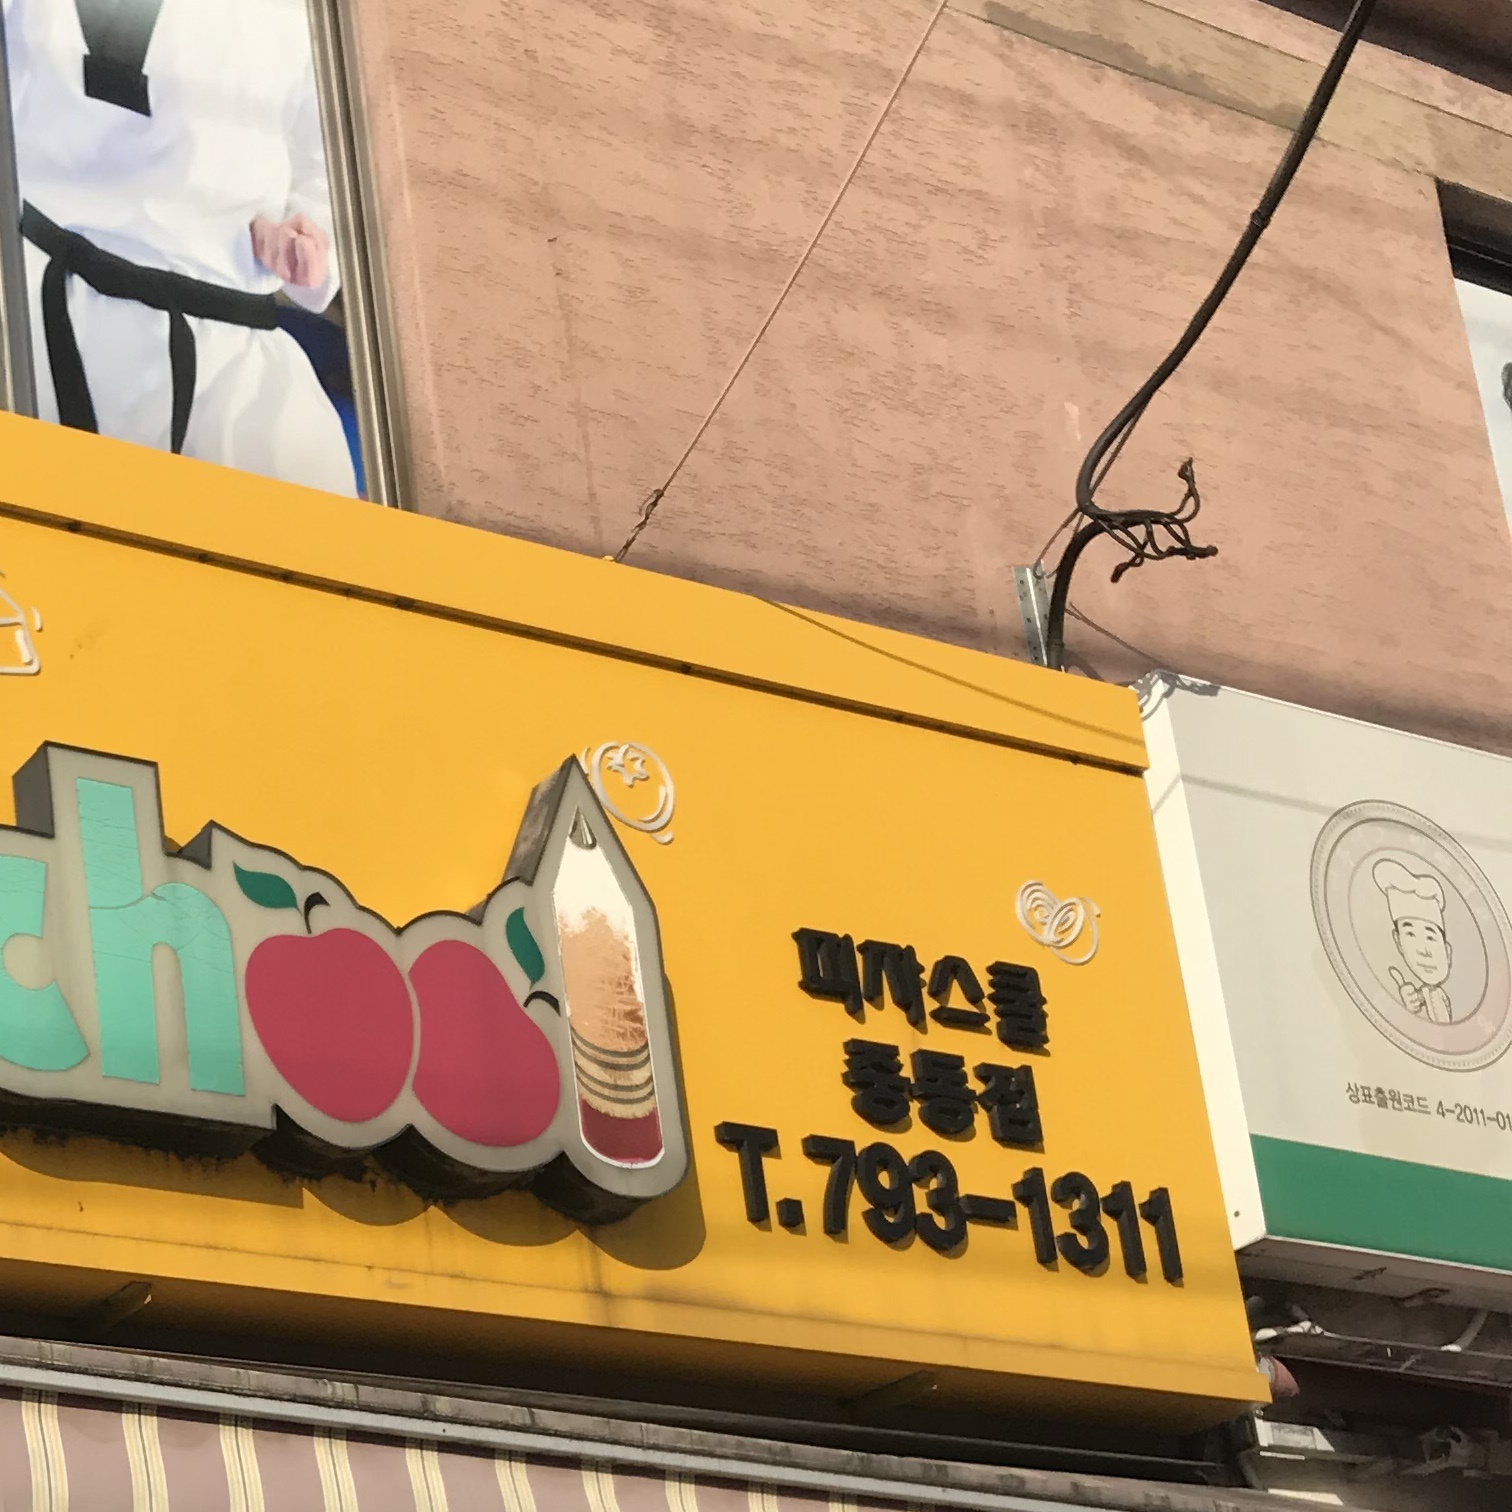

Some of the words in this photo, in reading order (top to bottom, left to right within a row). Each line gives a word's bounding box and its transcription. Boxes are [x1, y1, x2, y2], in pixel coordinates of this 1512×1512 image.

[792, 927, 1049, 1052] 피자스쿨
[1346, 1082, 1431, 1115] 상표출원코드
[714, 1121, 1183, 1284] T.793-1311
